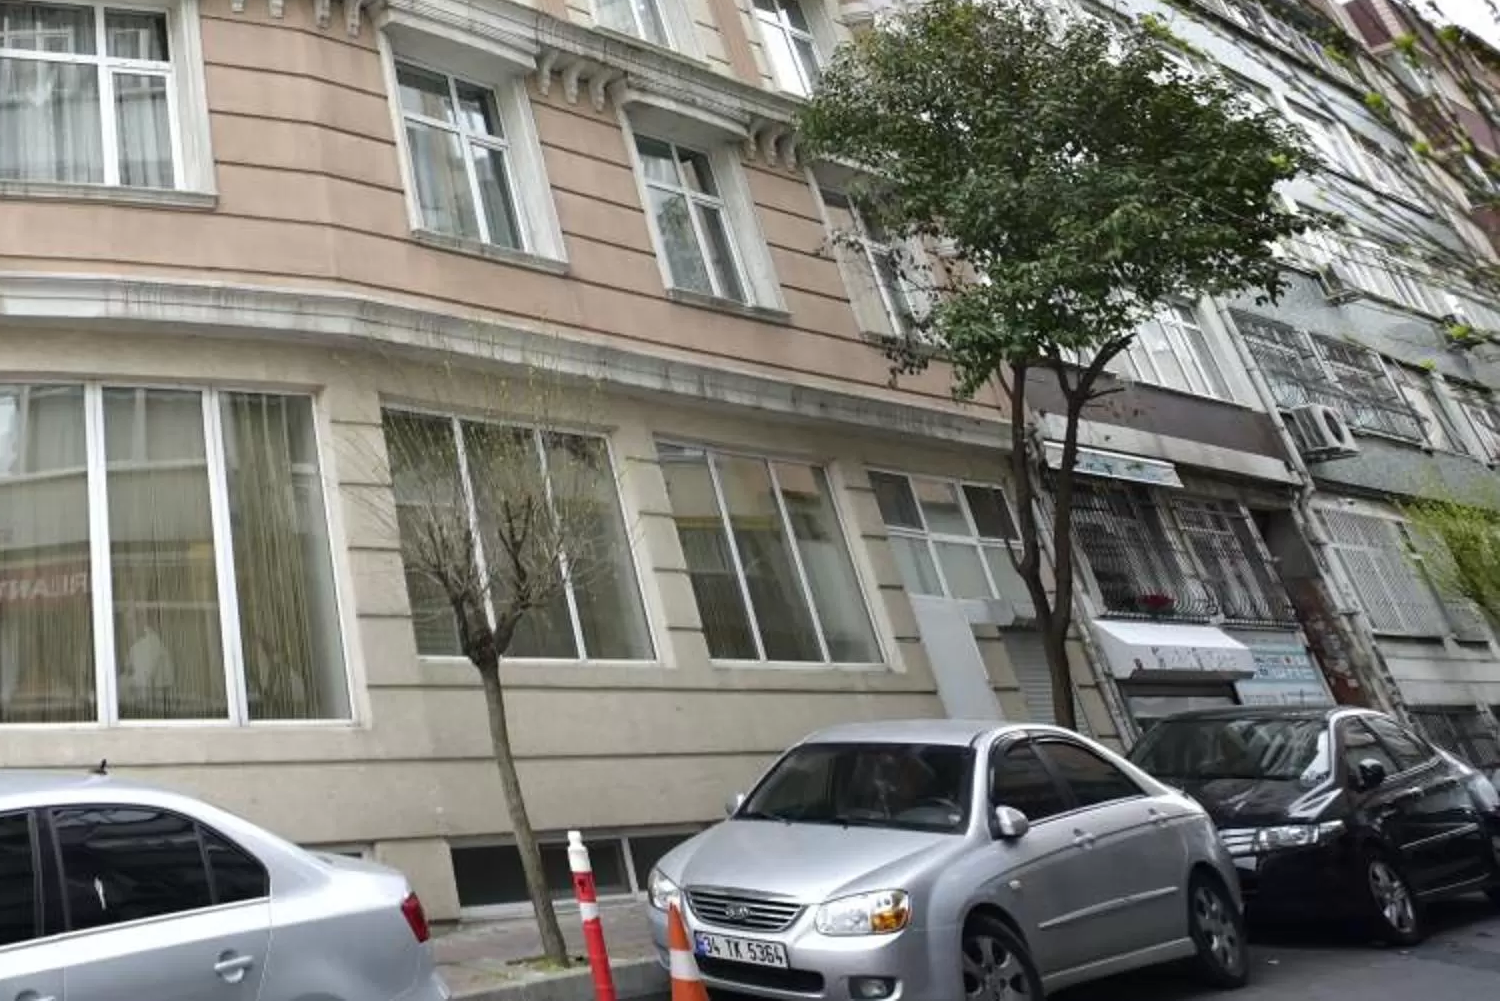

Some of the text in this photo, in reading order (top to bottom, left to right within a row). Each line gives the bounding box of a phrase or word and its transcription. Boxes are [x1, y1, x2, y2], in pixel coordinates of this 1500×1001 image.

[704, 936, 783, 964] 34 TK 5364
